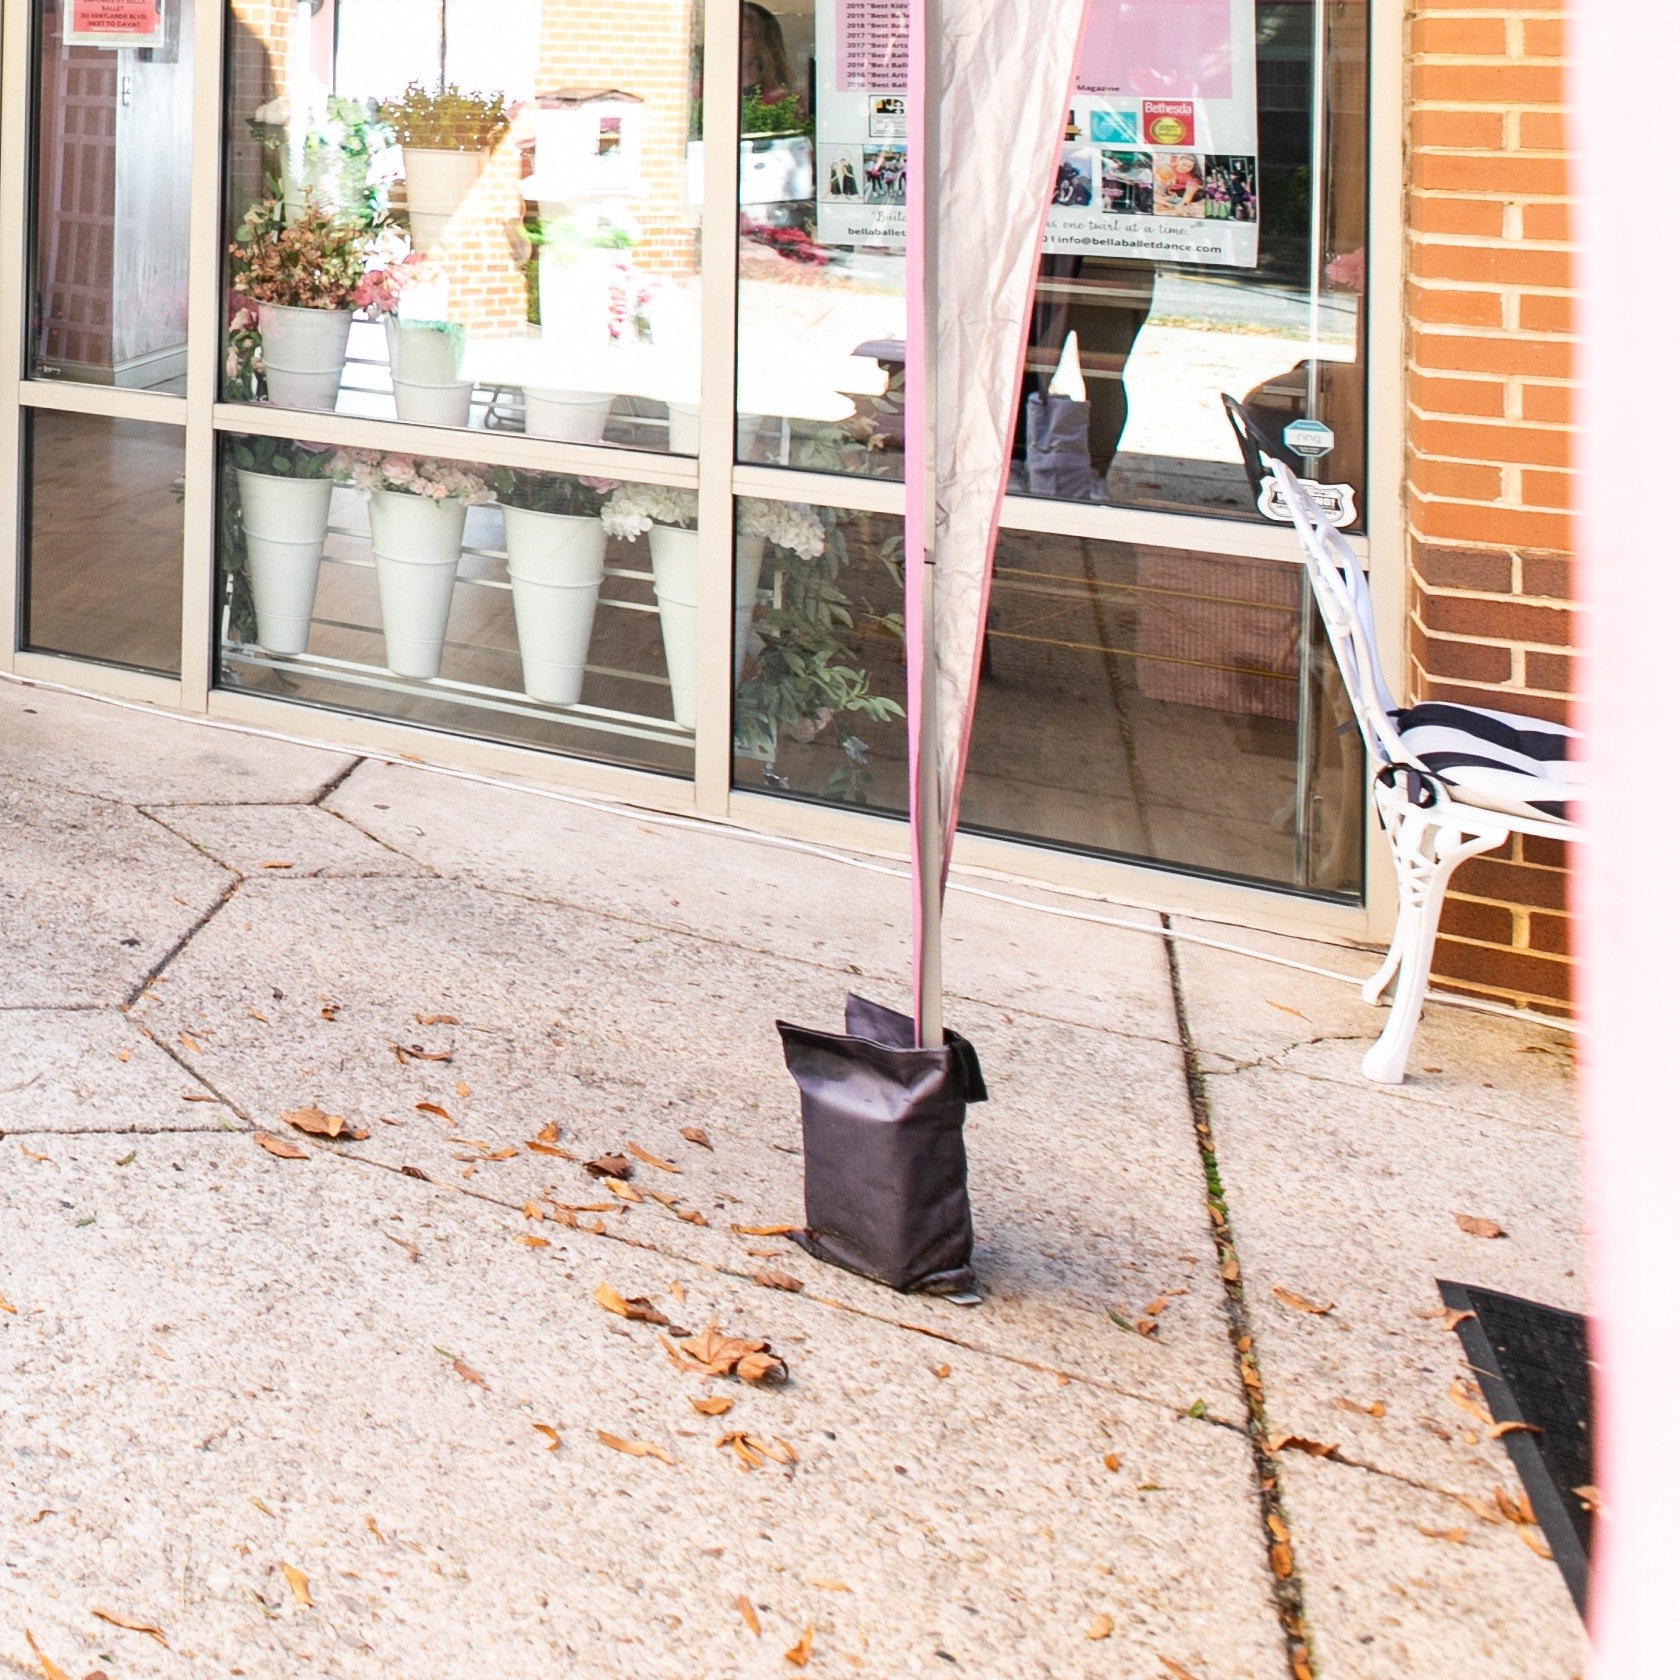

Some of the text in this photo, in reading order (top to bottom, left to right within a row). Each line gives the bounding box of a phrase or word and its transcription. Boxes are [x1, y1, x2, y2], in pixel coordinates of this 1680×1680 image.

[1077, 84, 1120, 92] Magazine
[1144, 102, 1192, 115] Bethesda
[1063, 221, 1084, 229] one
[1089, 219, 1121, 231] twirl
[1125, 222, 1139, 232] at
[1144, 225, 1155, 233] a
[848, 228, 906, 237] bellaballet
[1058, 236, 1222, 253] info@bellaballetdance.com
[1296, 433, 1321, 444] ring
